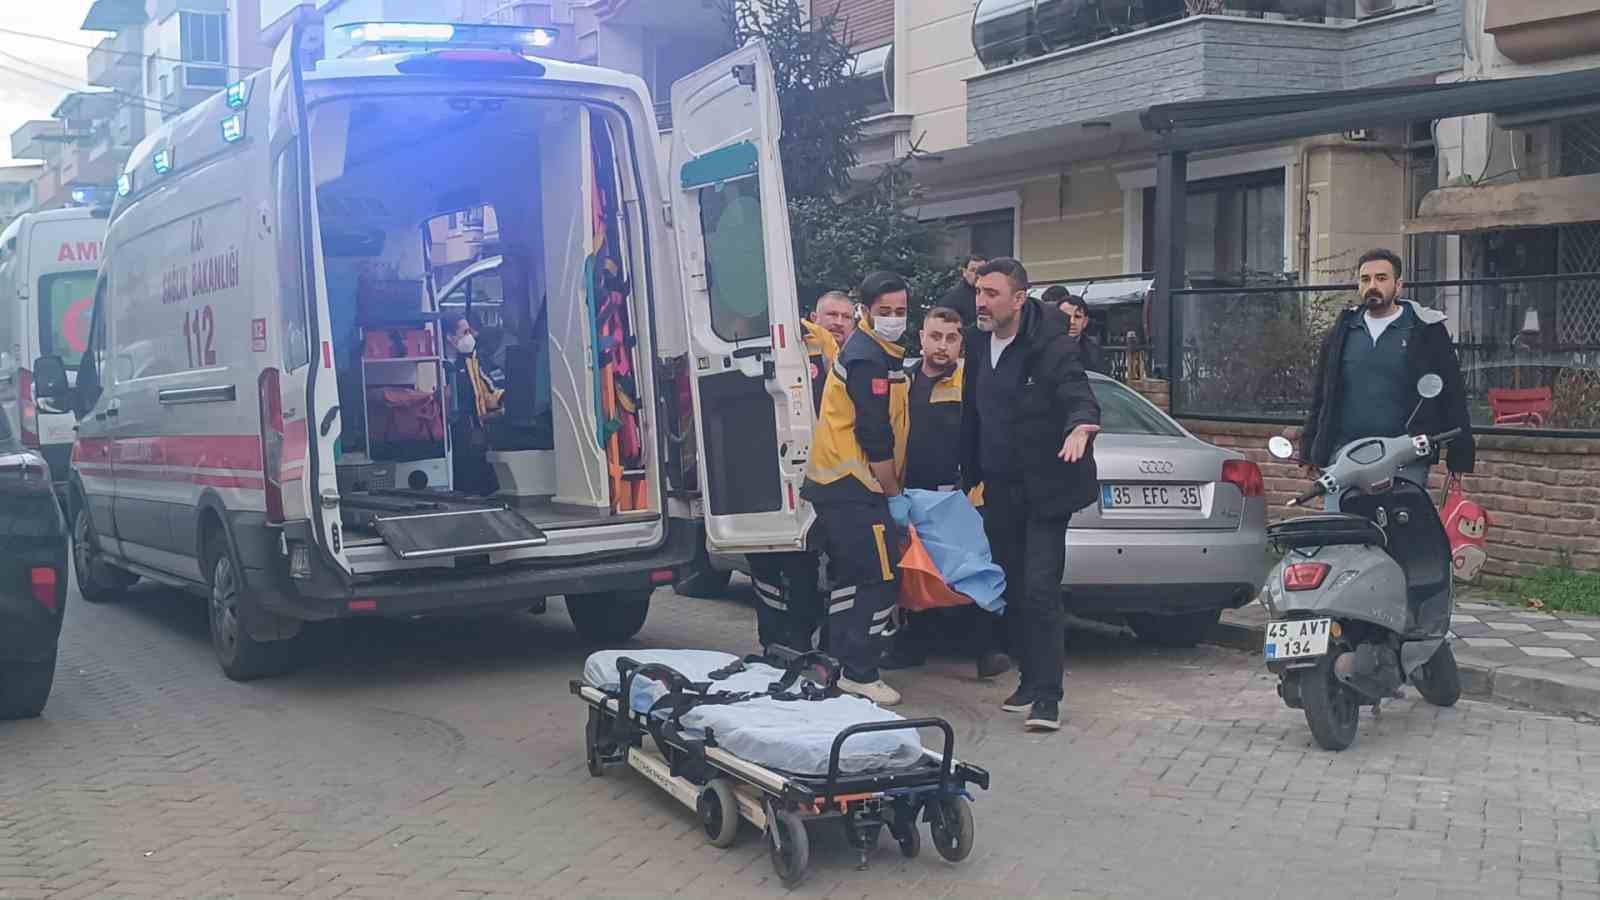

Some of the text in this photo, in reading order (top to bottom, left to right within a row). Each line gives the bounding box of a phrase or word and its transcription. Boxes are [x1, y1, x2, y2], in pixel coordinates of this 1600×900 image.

[184, 304, 216, 368] 112
[1114, 487, 1131, 504] 35
[1143, 487, 1168, 504] EFC
[1180, 487, 1197, 504] 35
[1269, 620, 1329, 638] 45 AVT
[1284, 641, 1311, 655] 134
